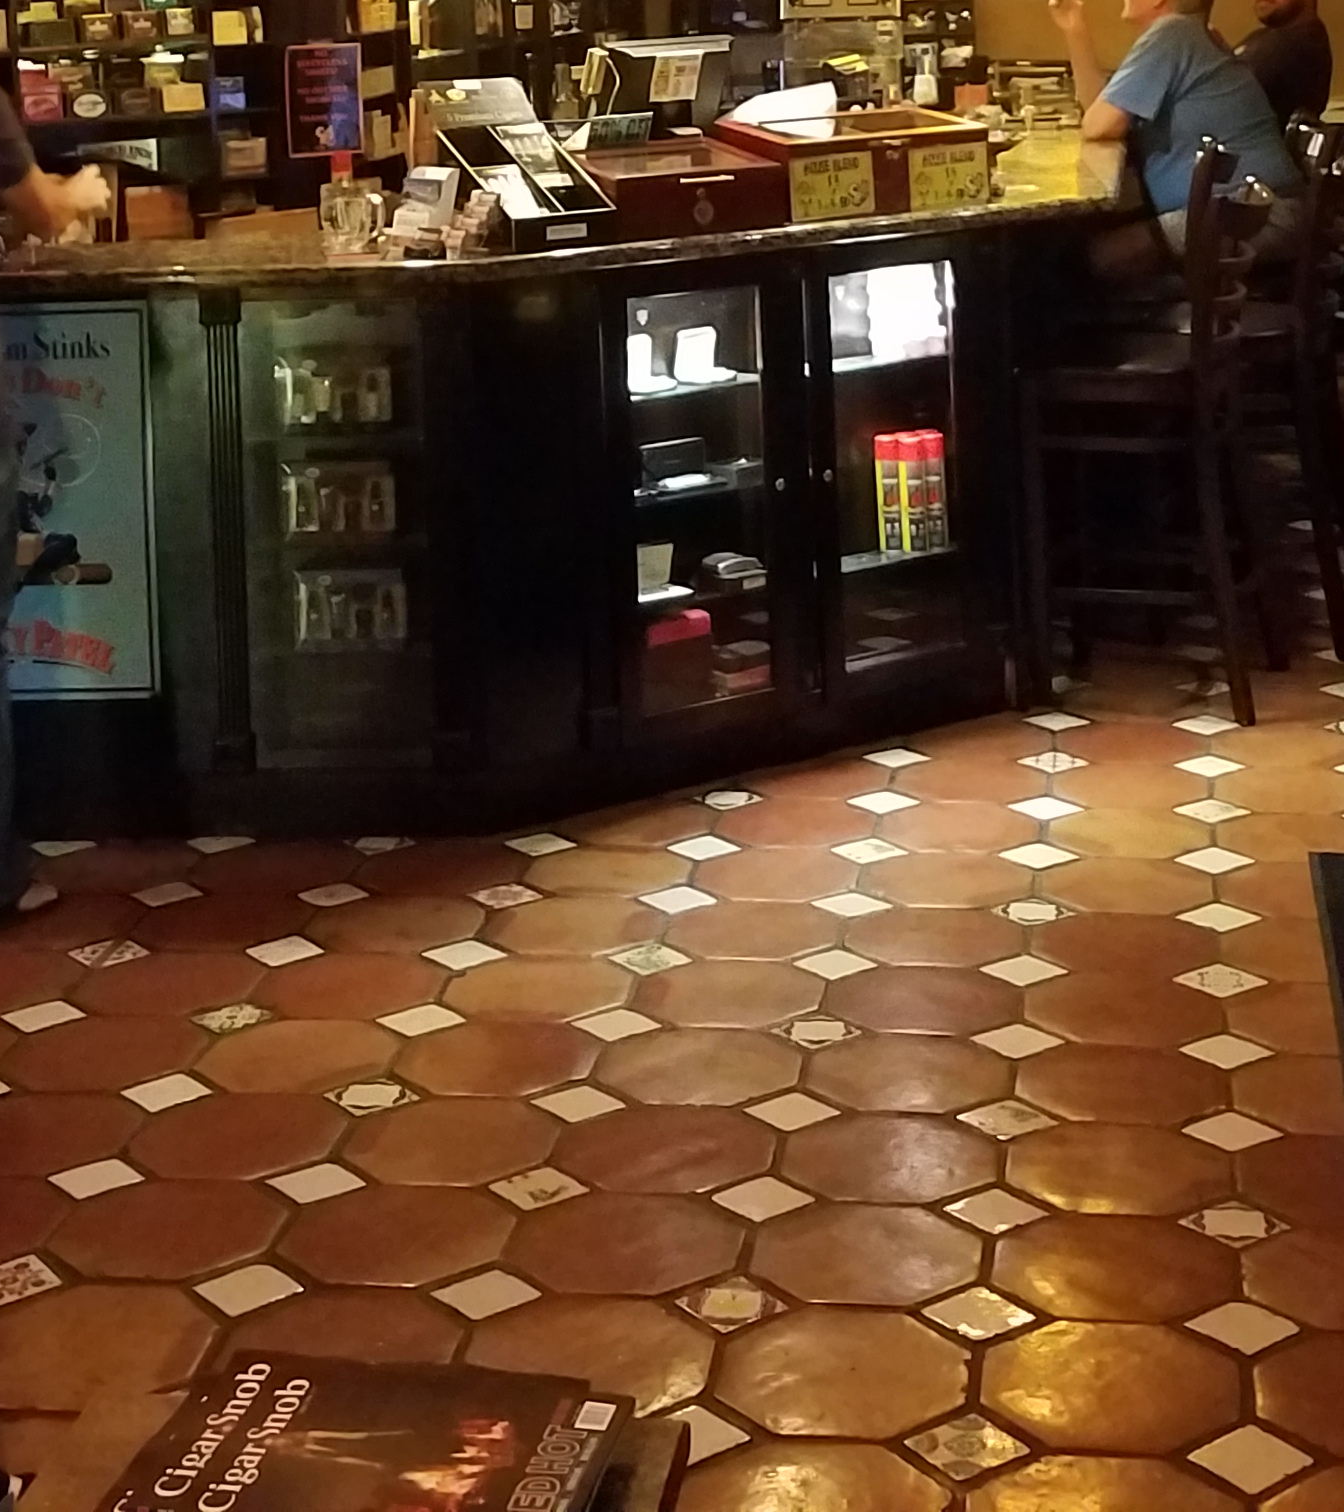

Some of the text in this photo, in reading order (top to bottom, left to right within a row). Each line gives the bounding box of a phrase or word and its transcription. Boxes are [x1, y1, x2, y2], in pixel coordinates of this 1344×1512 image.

[589, 118, 621, 143] 50%
[804, 156, 860, 175] HOUSE BLEND
[922, 150, 976, 167] HOUSE BLEND
[33, 331, 110, 361] Stinks
[154, 1363, 272, 1497] Cigar Snob
[198, 1378, 310, 1512] Cigar Snob
[525, 1424, 588, 1475] HOT
